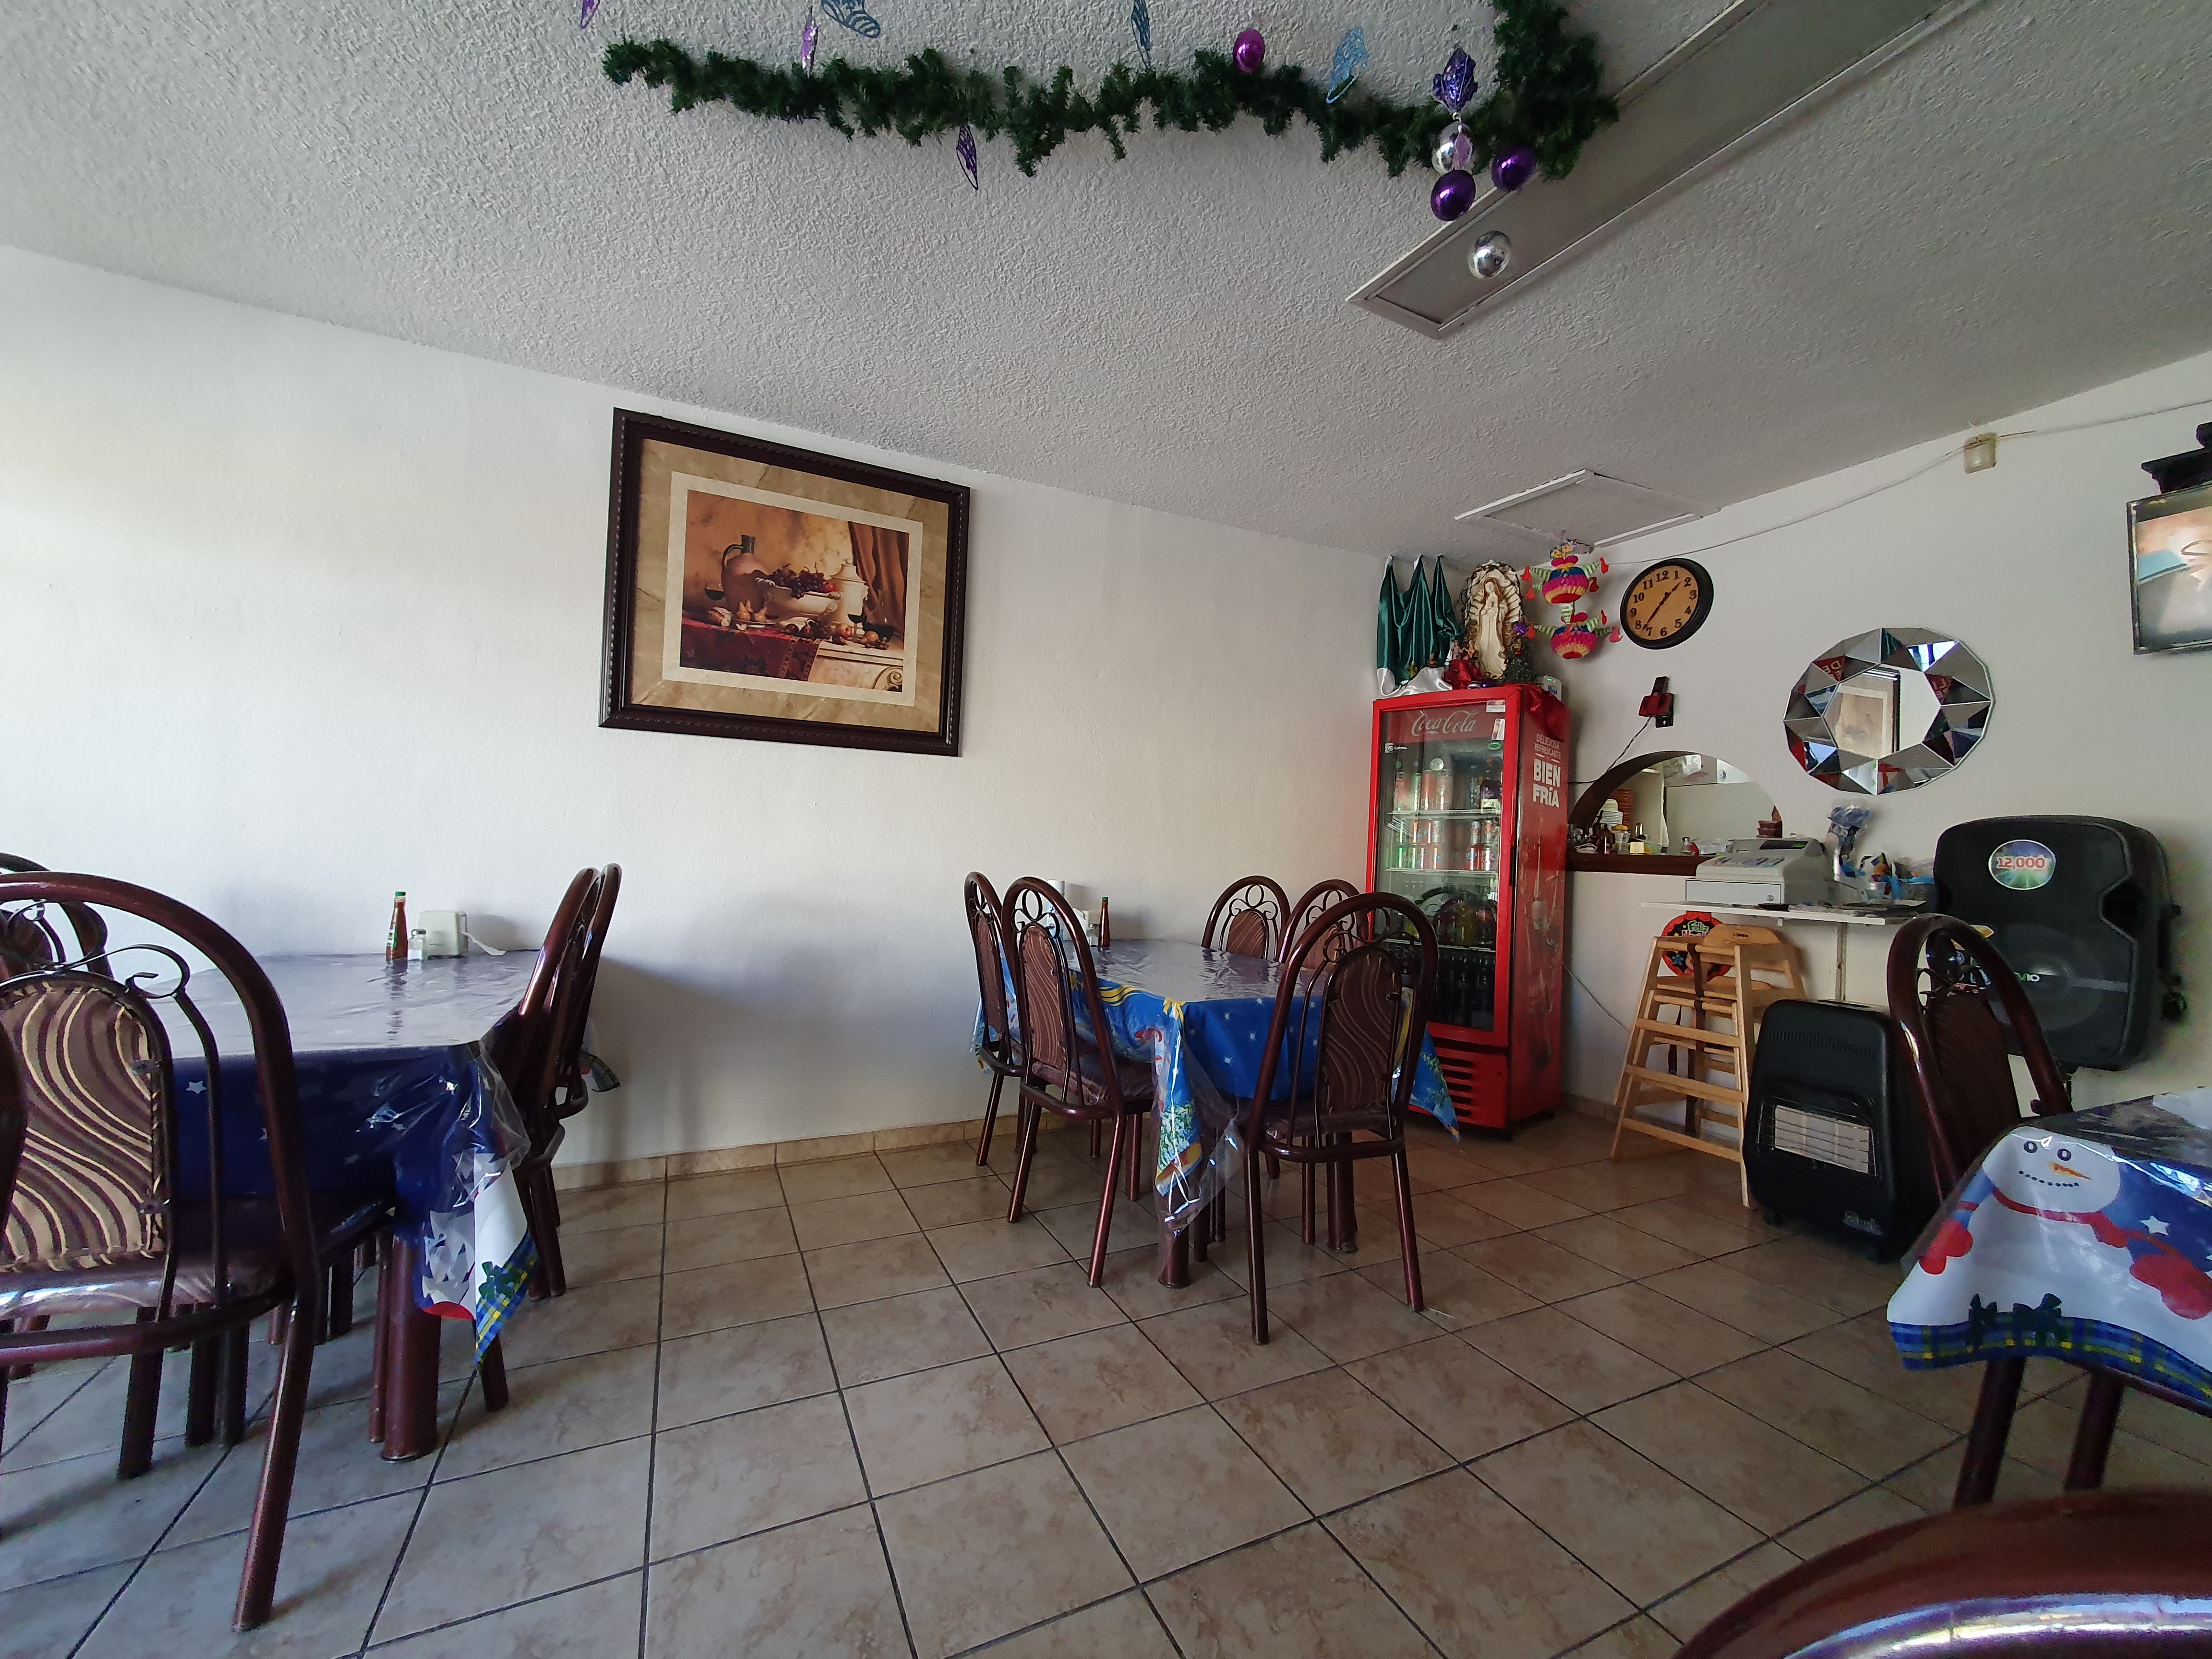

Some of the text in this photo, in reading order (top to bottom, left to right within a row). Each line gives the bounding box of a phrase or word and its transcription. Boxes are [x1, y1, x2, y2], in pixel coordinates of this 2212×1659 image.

[1655, 570, 1669, 582] 12
[1673, 570, 1679, 580] 1
[1643, 578, 1653, 590] 11
[1683, 577, 1692, 587] 2
[1633, 592, 1645, 603] 10
[1689, 589, 1697, 600] 3
[1630, 607, 1637, 617] 9
[1684, 605, 1691, 615] 4
[1635, 620, 1642, 629] 8
[1674, 618, 1682, 628] 5
[1646, 626, 1653, 637] 7
[1660, 627, 1667, 637] 6
[1411, 710, 1479, 736] Coca-Cola
[1533, 758, 1561, 787] BIEN
[1533, 783, 1560, 808] FRÍA
[1998, 857, 2045, 869] 12,000
[1687, 920, 1710, 933] Feliz
